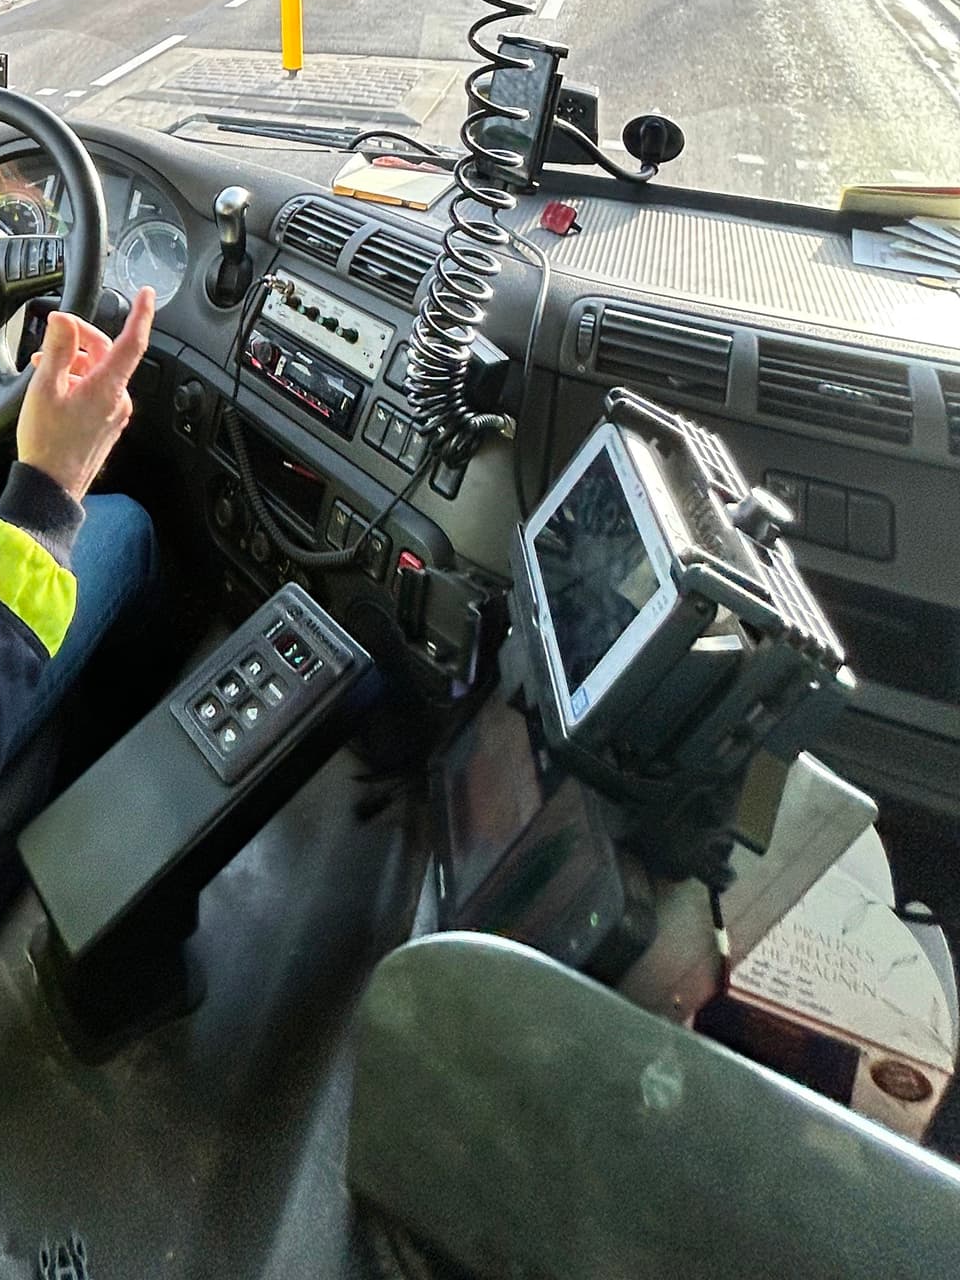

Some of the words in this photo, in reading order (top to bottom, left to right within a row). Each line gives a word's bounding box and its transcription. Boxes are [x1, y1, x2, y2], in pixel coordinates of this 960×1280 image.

[250, 662, 262, 675] R
[224, 683, 239, 697] N
[205, 707, 217, 718] D
